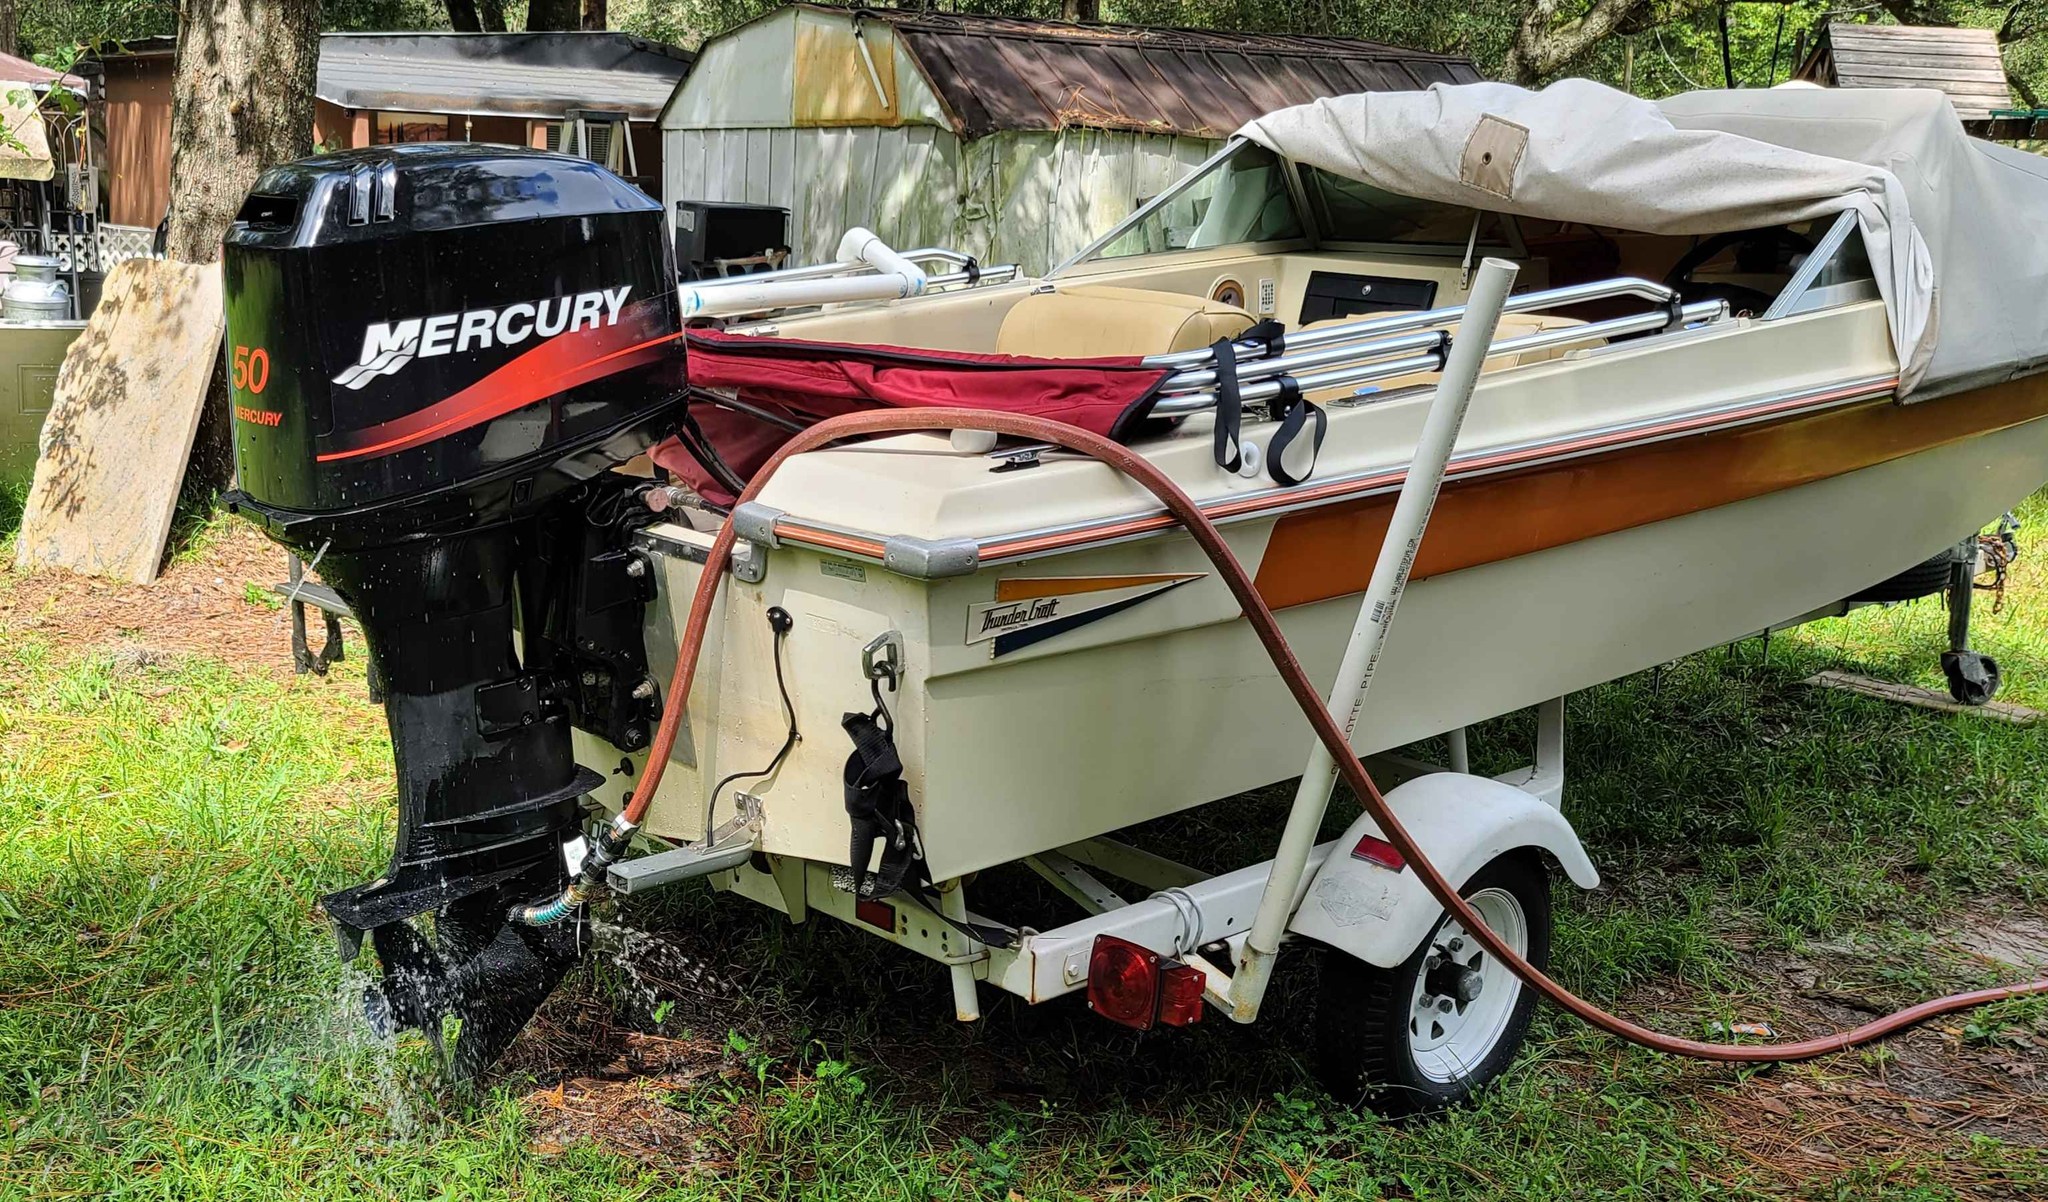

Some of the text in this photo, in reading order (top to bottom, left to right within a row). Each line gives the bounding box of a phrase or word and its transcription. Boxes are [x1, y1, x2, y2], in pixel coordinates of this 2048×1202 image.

[360, 285, 633, 366] MERCURY
[233, 345, 269, 394] 50
[234, 405, 283, 427] MERCURY
[979, 598, 1060, 634] Thunder Craft
